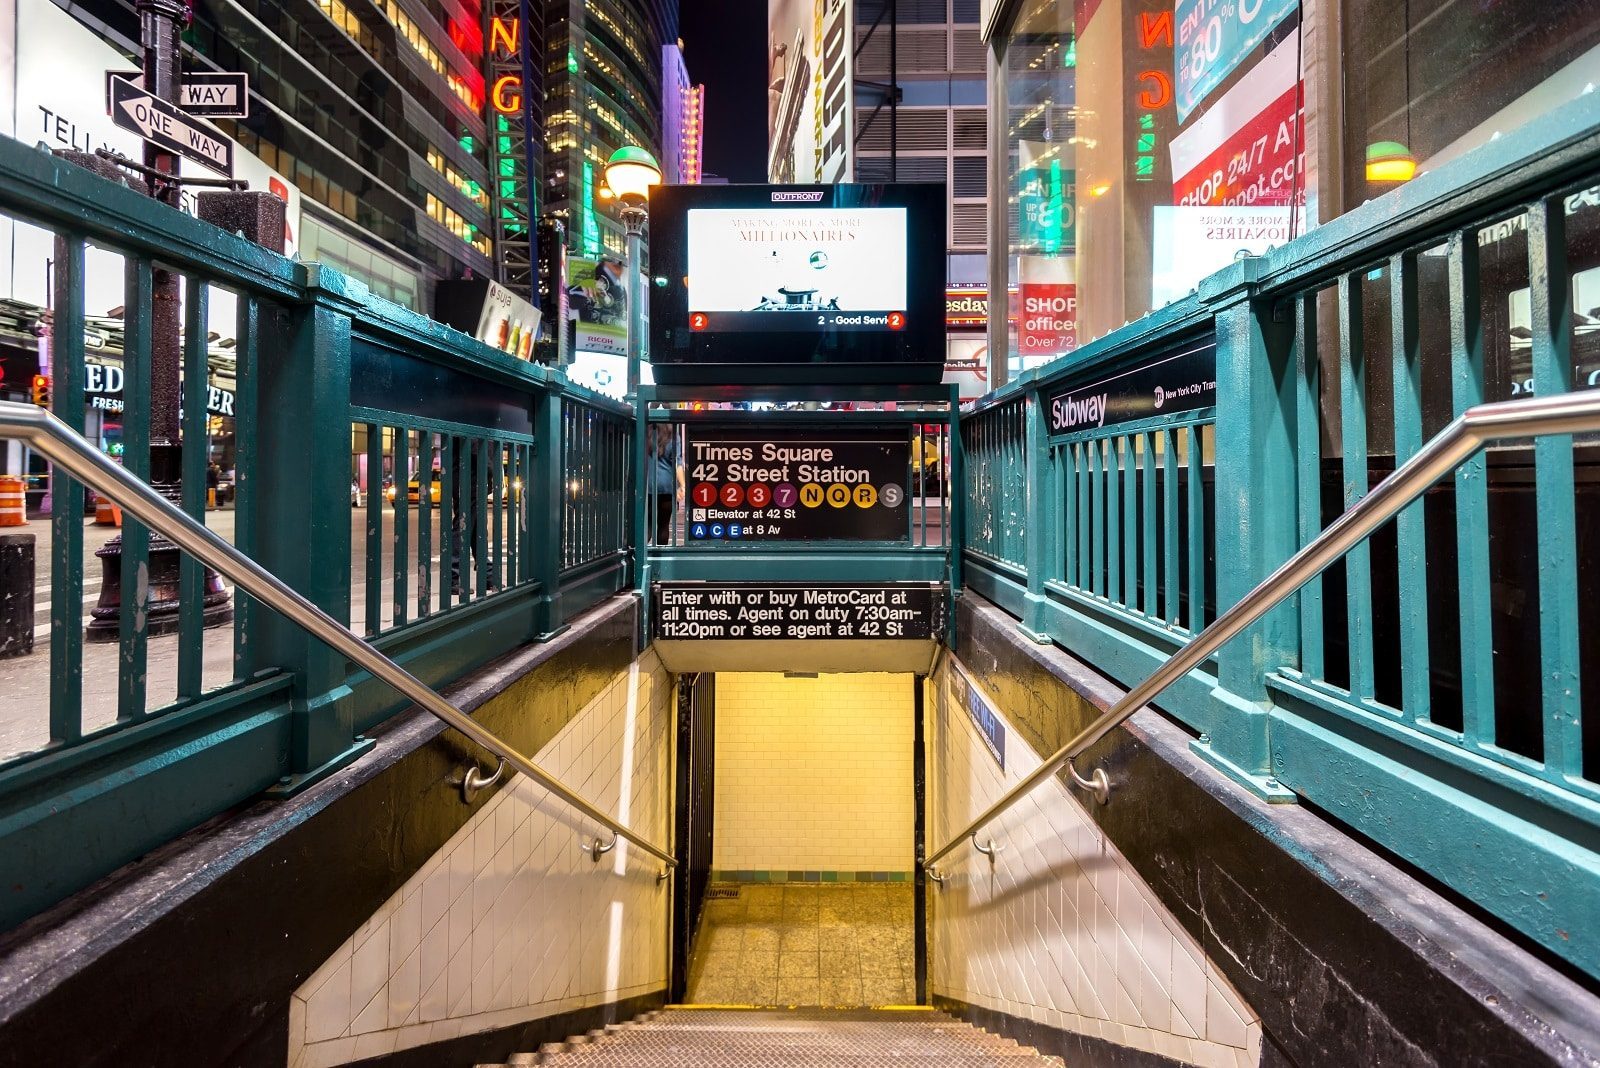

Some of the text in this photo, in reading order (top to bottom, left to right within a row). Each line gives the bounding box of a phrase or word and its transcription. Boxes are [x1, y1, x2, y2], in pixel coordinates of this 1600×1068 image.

[189, 87, 228, 103] WAY
[136, 104, 220, 159] ONE WAY
[1227, 134, 1268, 187] 24/7
[1273, 107, 1305, 154] AT
[1026, 203, 1037, 212] UP
[829, 218, 863, 227] MORE
[1026, 213, 1037, 222] TO
[739, 230, 856, 242] MILLIONAIRES
[1025, 297, 1077, 313] SHOP
[817, 316, 825, 325] 2
[836, 315, 862, 325] Good
[588, 336, 613, 344] RICOH
[1025, 336, 1055, 347] Over
[84, 364, 124, 393] ED
[206, 384, 234, 416] ER
[1165, 390, 1177, 399] New
[1177, 386, 1190, 397] York
[1190, 383, 1202, 394] City
[92, 397, 125, 411] FRESH
[1052, 393, 1108, 430] Subway
[692, 443, 834, 464] Times Square
[691, 463, 870, 483] 42 Street Station
[707, 509, 796, 519] Elevator at 42 St
[742, 526, 753, 535] at
[756, 525, 764, 535] 8
[768, 525, 781, 535] Av
[662, 591, 907, 607] Enter with or buy MetroCard at
[662, 606, 922, 623] all times. Agent on duty 7:30am-
[662, 622, 904, 639] 11:20pm or see agent at 42 St
